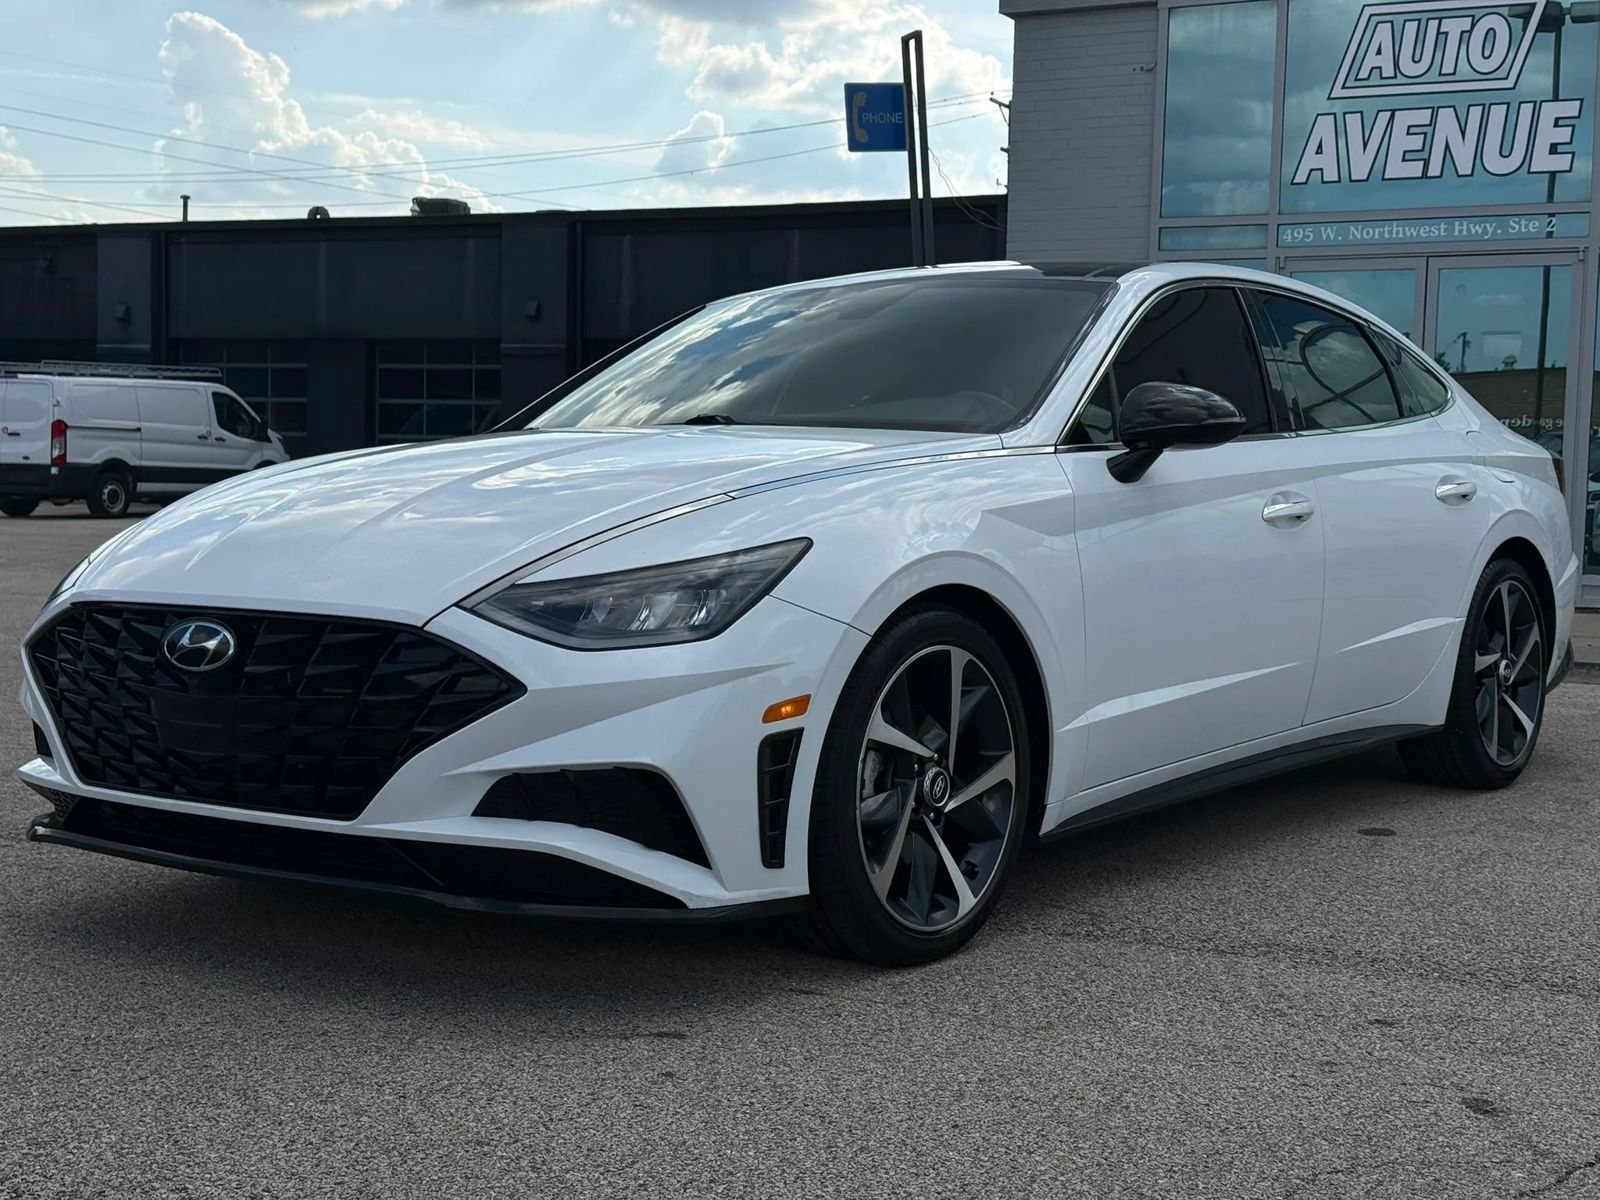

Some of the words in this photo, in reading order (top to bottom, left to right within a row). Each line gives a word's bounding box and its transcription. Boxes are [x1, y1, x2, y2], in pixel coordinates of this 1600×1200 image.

[1355, 12, 1512, 81] AUTO
[862, 112, 903, 124] PHONE
[1291, 99, 1583, 185] AVENUE
[1282, 228, 1314, 242] 495
[1320, 226, 1343, 241] W.
[1349, 222, 1448, 241] Northwest
[1453, 220, 1502, 240] Hwy.
[1508, 217, 1540, 234] Ste
[1545, 217, 1557, 232] 2
